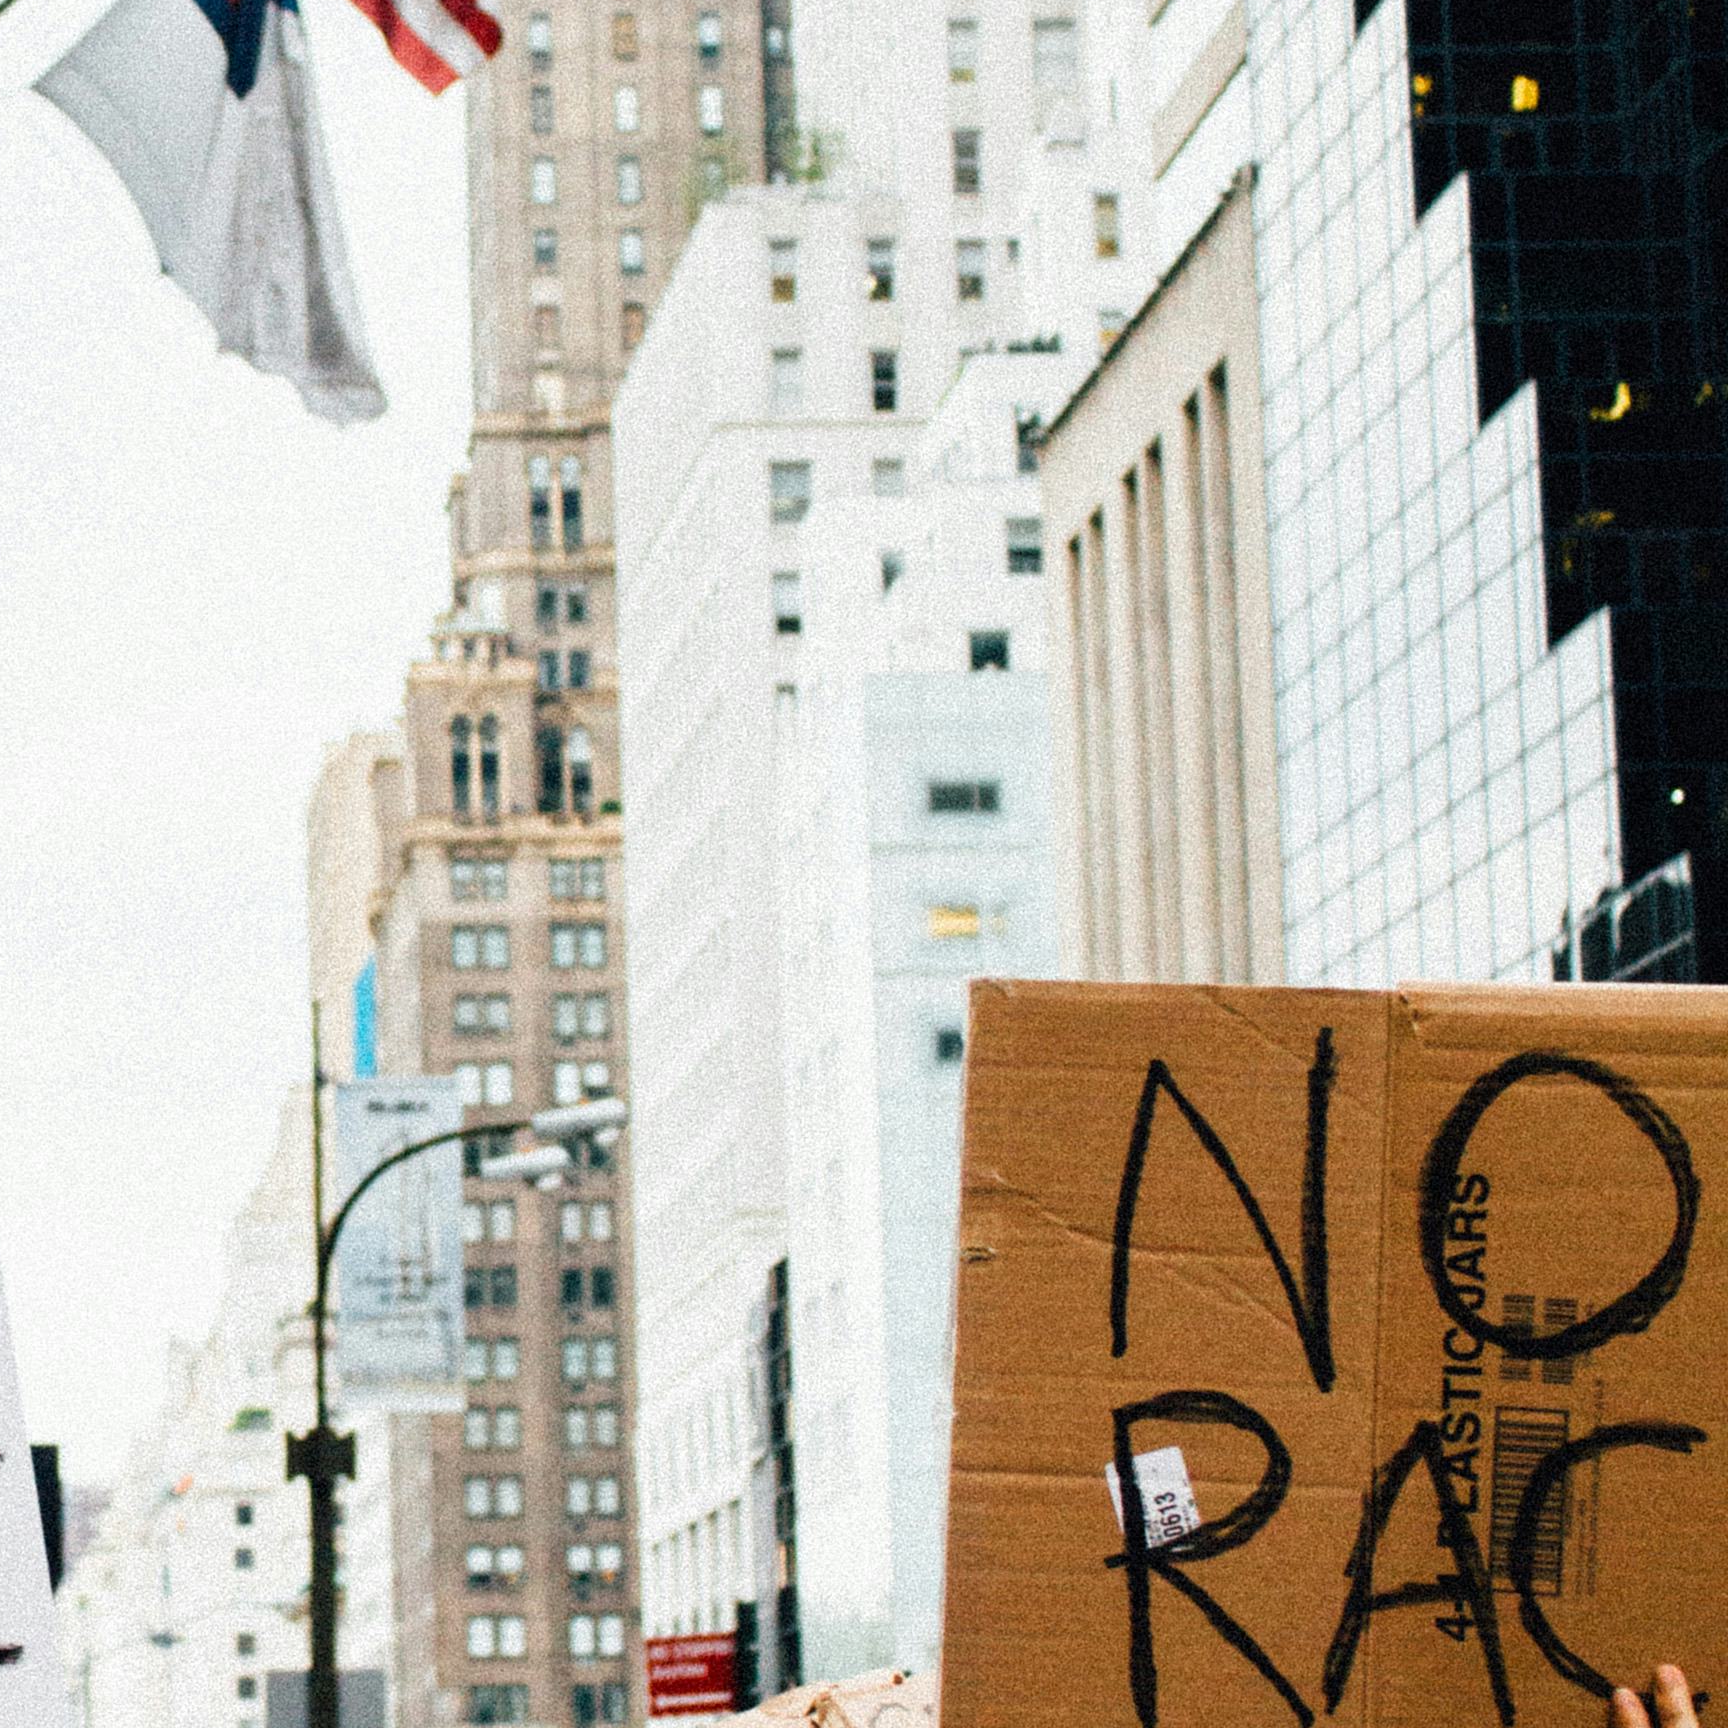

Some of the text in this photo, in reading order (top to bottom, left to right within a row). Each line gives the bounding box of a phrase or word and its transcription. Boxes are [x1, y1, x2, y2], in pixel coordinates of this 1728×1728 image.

[1110, 1025, 1702, 1394] NO
[1445, 1173, 1492, 1311] JARS
[1153, 1491, 1185, 1538] 0613
